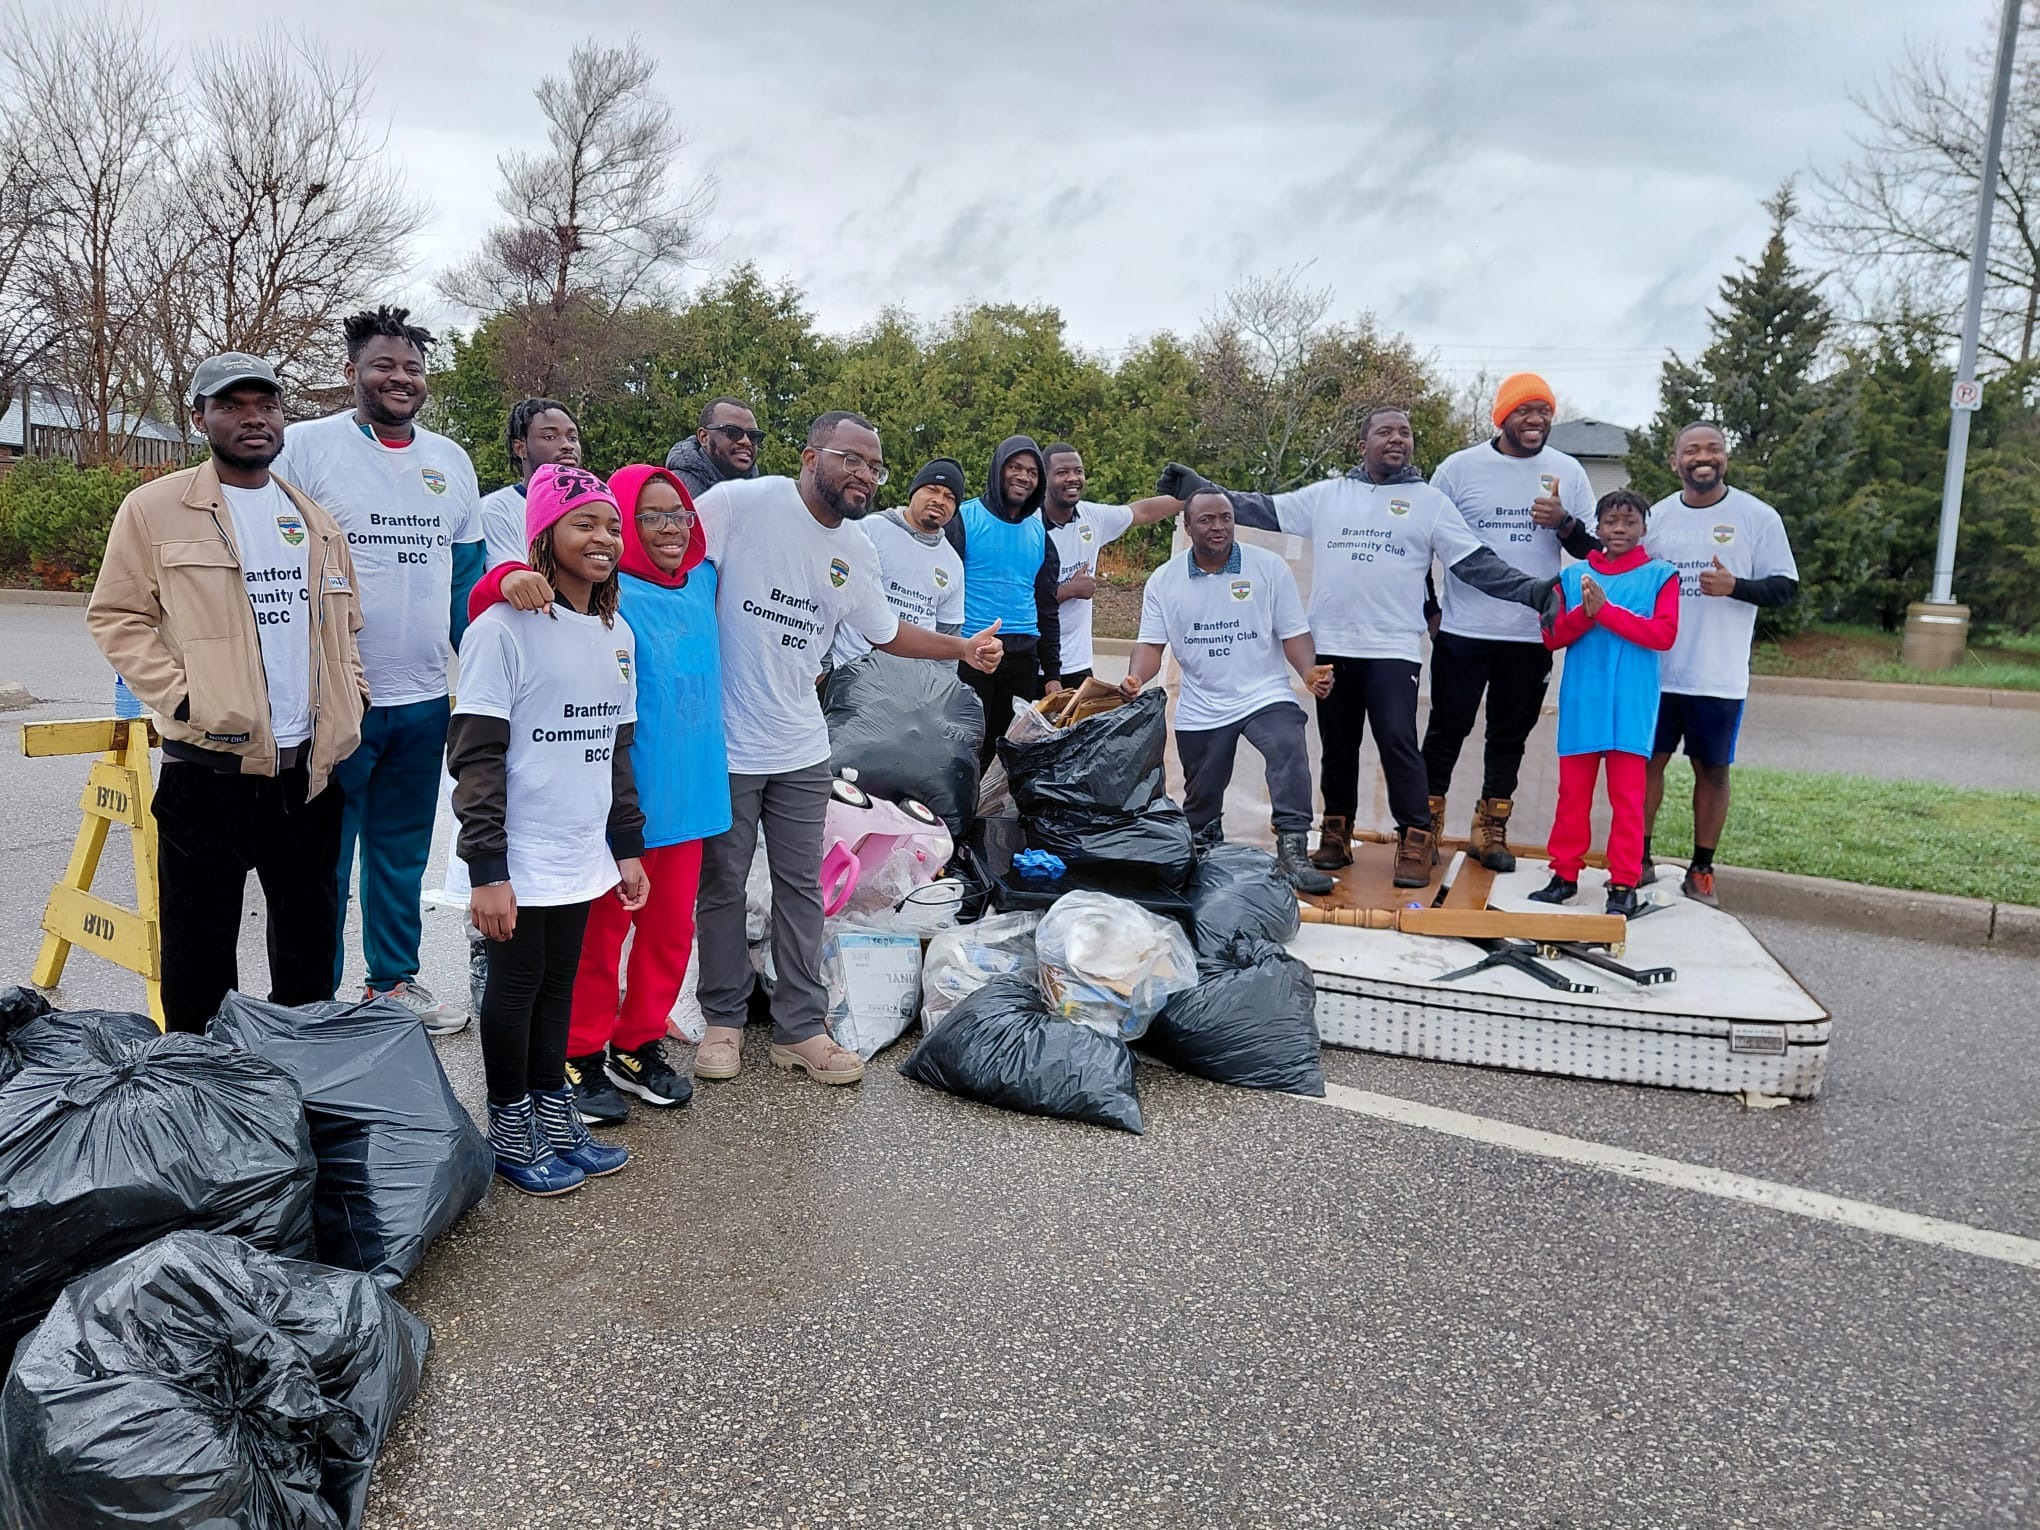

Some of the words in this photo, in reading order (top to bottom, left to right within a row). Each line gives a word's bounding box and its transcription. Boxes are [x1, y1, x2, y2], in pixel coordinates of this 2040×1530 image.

[1495, 507, 1530, 516] Brantf
[370, 513, 440, 528] Brantford
[1478, 519, 1538, 532] Community
[347, 532, 433, 549] Community
[1341, 527, 1392, 539] Brantford
[1510, 533, 1533, 542] BCC
[1327, 540, 1382, 553] Community
[1384, 543, 1406, 557] Club
[397, 551, 428, 564] BCC
[1351, 552, 1374, 562] BCC
[244, 566, 302, 582] antford
[885, 594, 925, 615] mmunity
[258, 610, 291, 626] BCC
[743, 600, 817, 636] Community
[899, 611, 920, 625] BCC
[1193, 619, 1240, 631] Brantford
[781, 633, 808, 650] BCC
[1183, 633, 1234, 645] Community
[1236, 630, 1258, 641] Club
[1208, 647, 1231, 657] BCC
[584, 747, 610, 763] BCC
[96, 785, 128, 813] BTD
[83, 912, 115, 941] BTD
